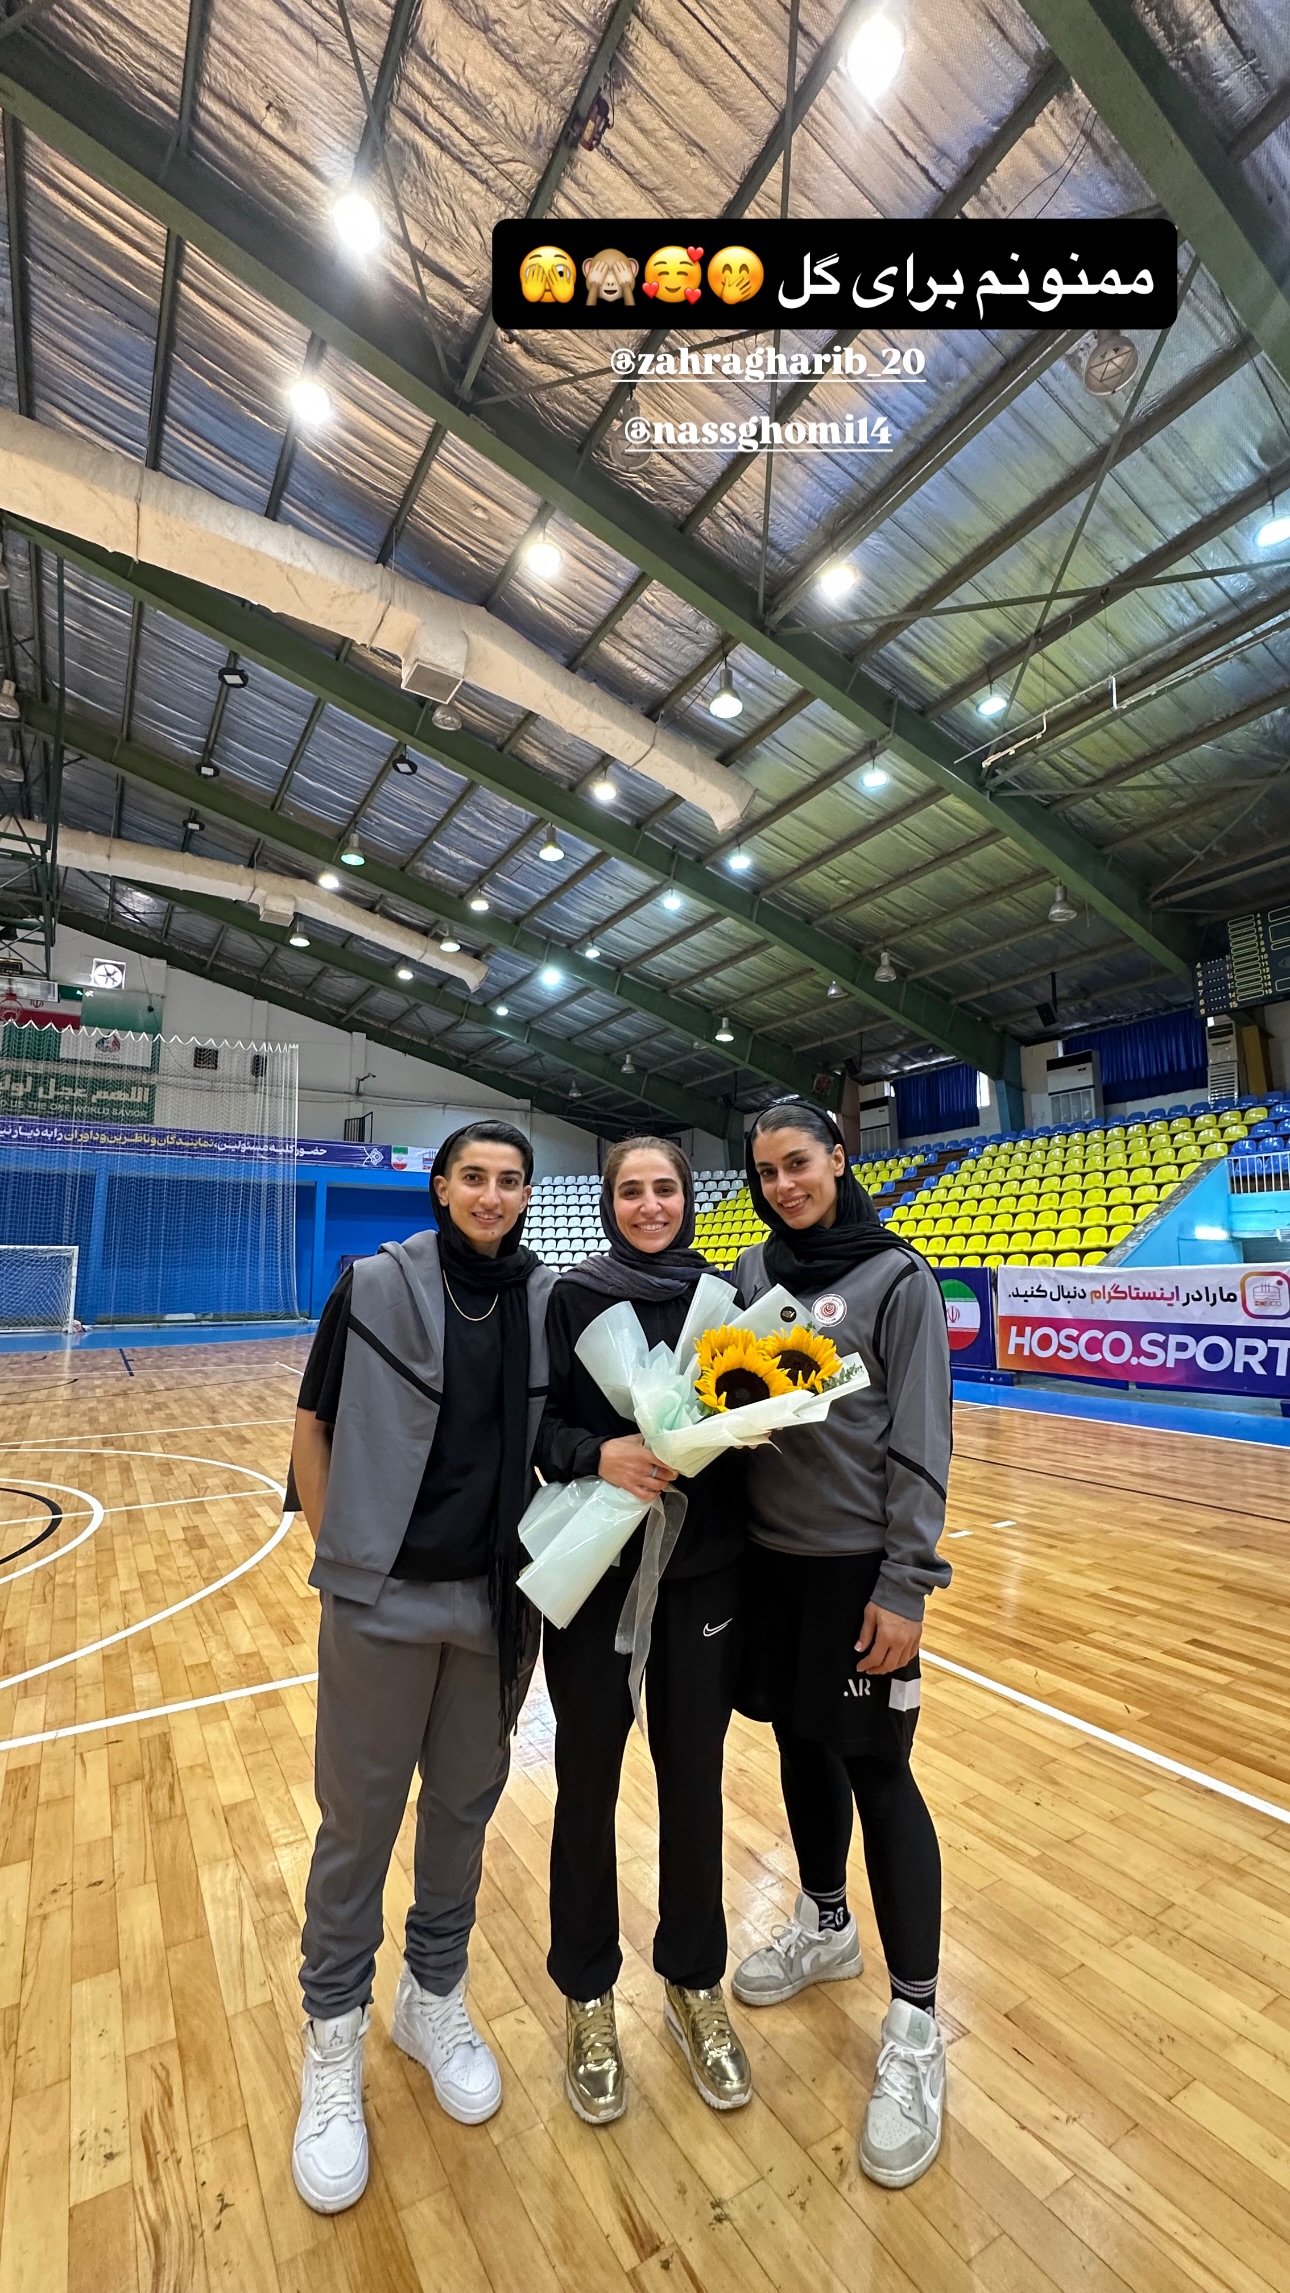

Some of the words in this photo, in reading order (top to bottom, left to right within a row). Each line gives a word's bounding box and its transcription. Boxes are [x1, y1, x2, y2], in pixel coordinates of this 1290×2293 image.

[1198, 989, 1204, 997] 7
[1229, 991, 1236, 999] 14
[1229, 1000, 1239, 1009] 15
[50, 1103, 73, 1112] ONE
[74, 1105, 110, 1115] WORLD
[112, 1107, 148, 1118] SAVIOR
[11, 1125, 41, 1139] دیار
[41, 1128, 54, 1140] به
[54, 1127, 64, 1141] را
[107, 1132, 150, 1145] ناظرین
[157, 1132, 214, 1149] نمایندگان
[294, 1146, 328, 1158] حضور
[1008, 1284, 1048, 1303] کنید.
[1049, 1284, 1087, 1304] دنبال
[1089, 1283, 1180, 1307] اینستاگرام
[1182, 1289, 1204, 1307] در
[1204, 1286, 1217, 1307] را
[1217, 1286, 1238, 1303] ما
[1007, 1325, 1290, 1377] HOSCO.SPORT
